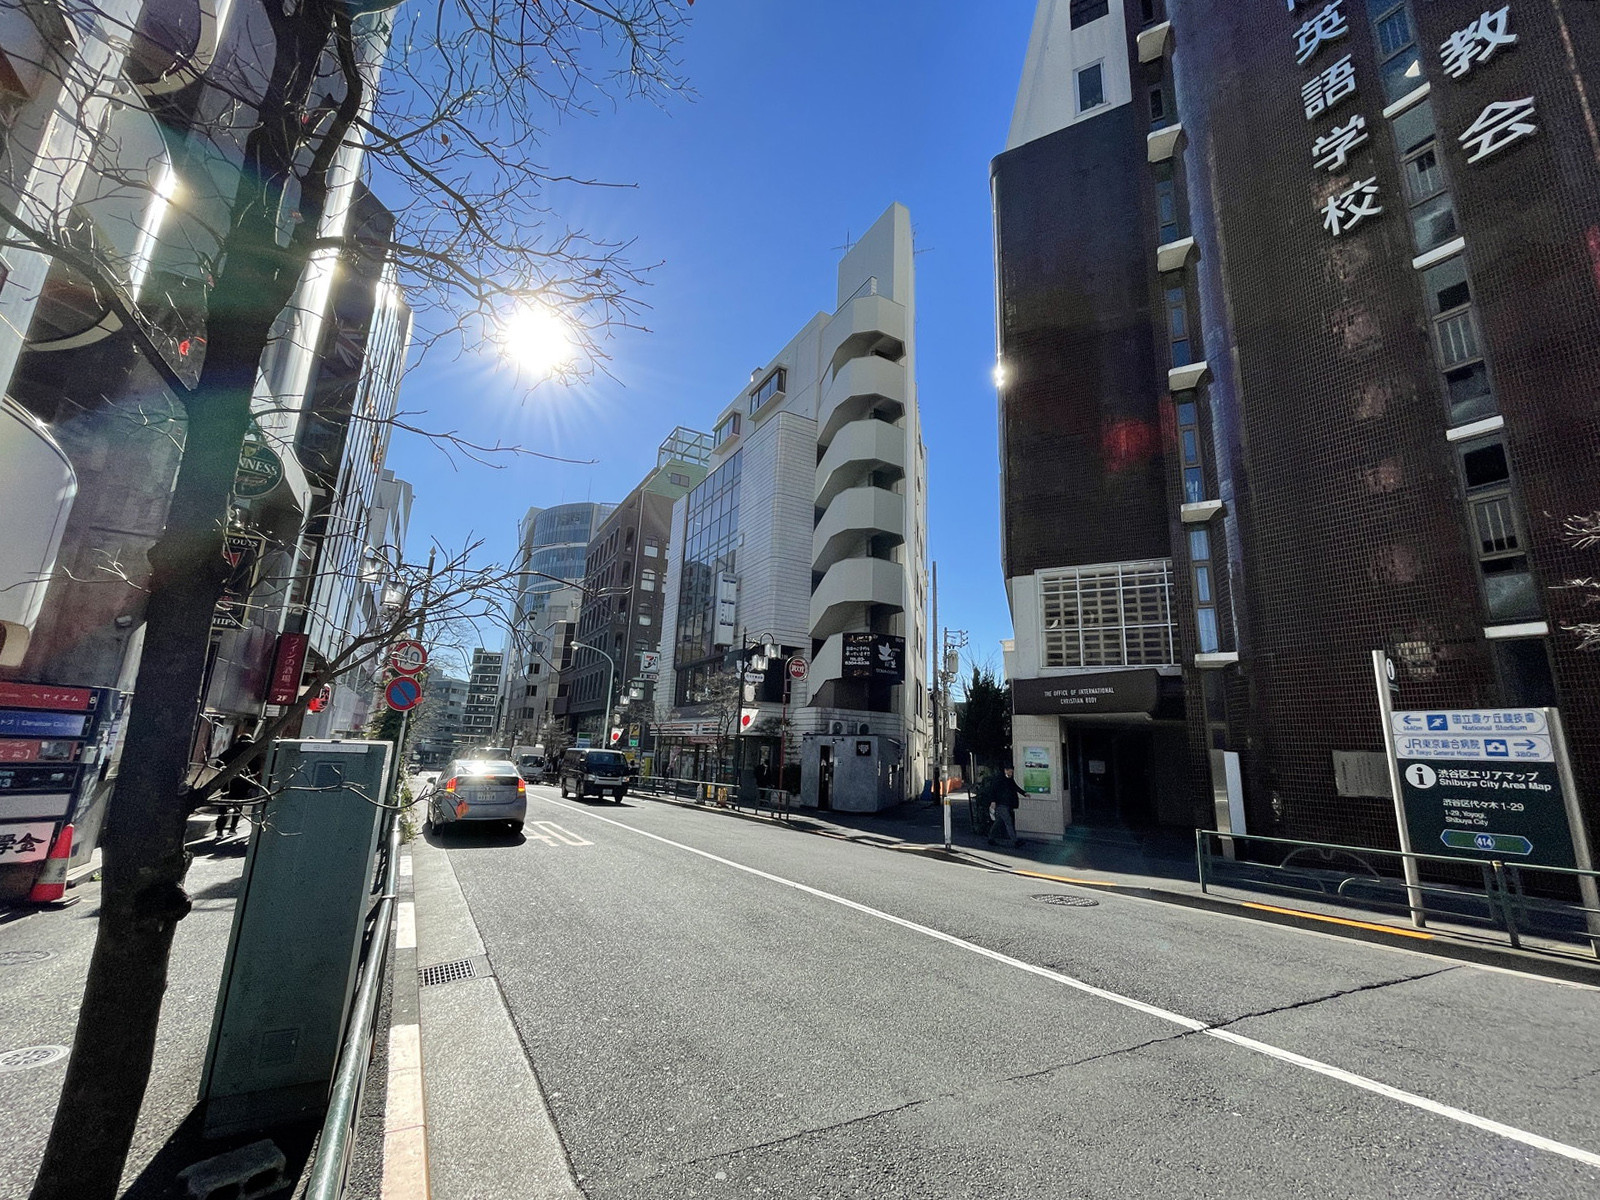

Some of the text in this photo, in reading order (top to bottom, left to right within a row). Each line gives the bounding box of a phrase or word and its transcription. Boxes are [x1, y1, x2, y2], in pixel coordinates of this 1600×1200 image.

[1440, 5, 1537, 164] 教会
[1288, 0, 1383, 236] 英語学校
[239, 457, 278, 476] NNESS
[228, 537, 258, 548] TOUTS
[213, 617, 237, 627] HIPS
[1078, 687, 1115, 695] INTERNATIONAL
[276, 694, 288, 702] 2F
[1438, 768, 1539, 781] 渋谷区エリアマップ
[1439, 778, 1552, 792] Shibuya City Area Map
[1501, 802, 1525, 812] 1-29
[1445, 816, 1489, 827] Shibuya City
[1477, 837, 1492, 846] 414
